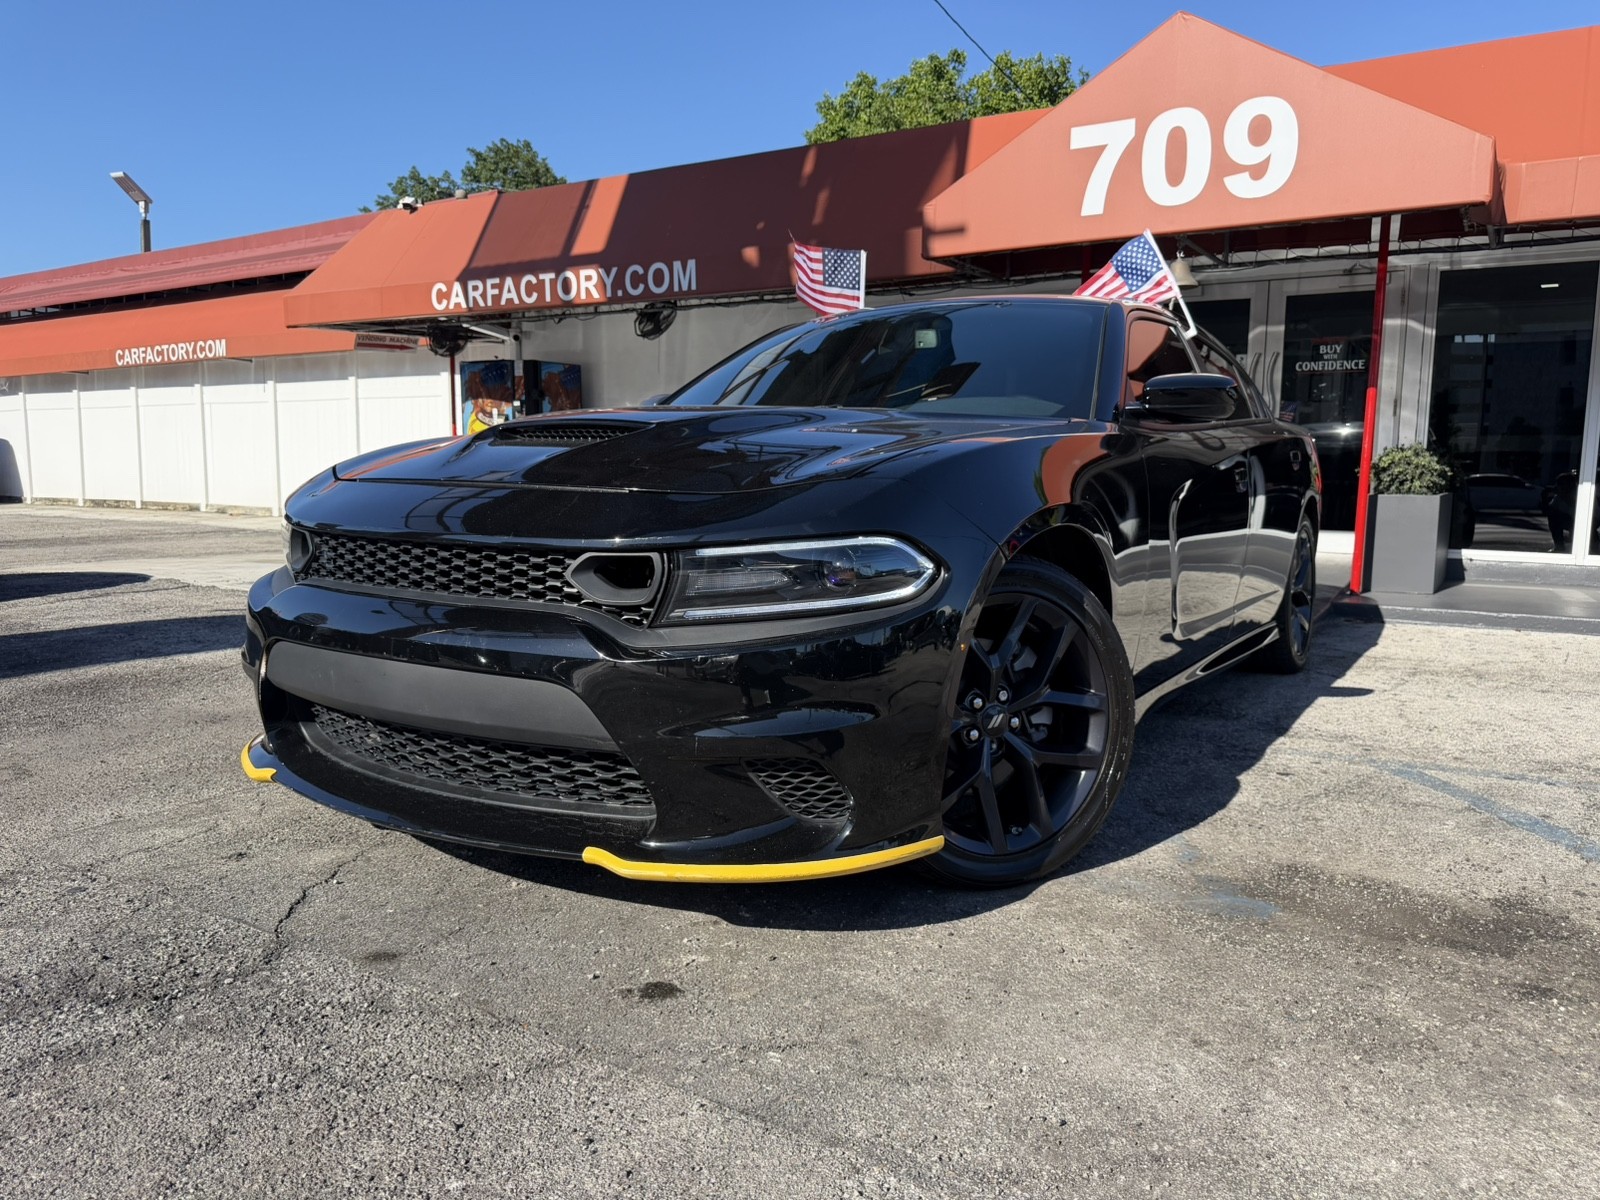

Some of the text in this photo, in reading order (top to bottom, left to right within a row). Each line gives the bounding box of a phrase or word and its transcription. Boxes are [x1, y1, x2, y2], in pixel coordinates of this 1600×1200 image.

[1069, 96, 1299, 217] 709
[431, 259, 697, 311] CARFACTORY.COM
[358, 334, 418, 345] VENDING MACHINE
[1319, 344, 1343, 354] BUY
[115, 339, 226, 366] CARFACTORY.COM
[1295, 360, 1366, 371] CONFIDENCE
